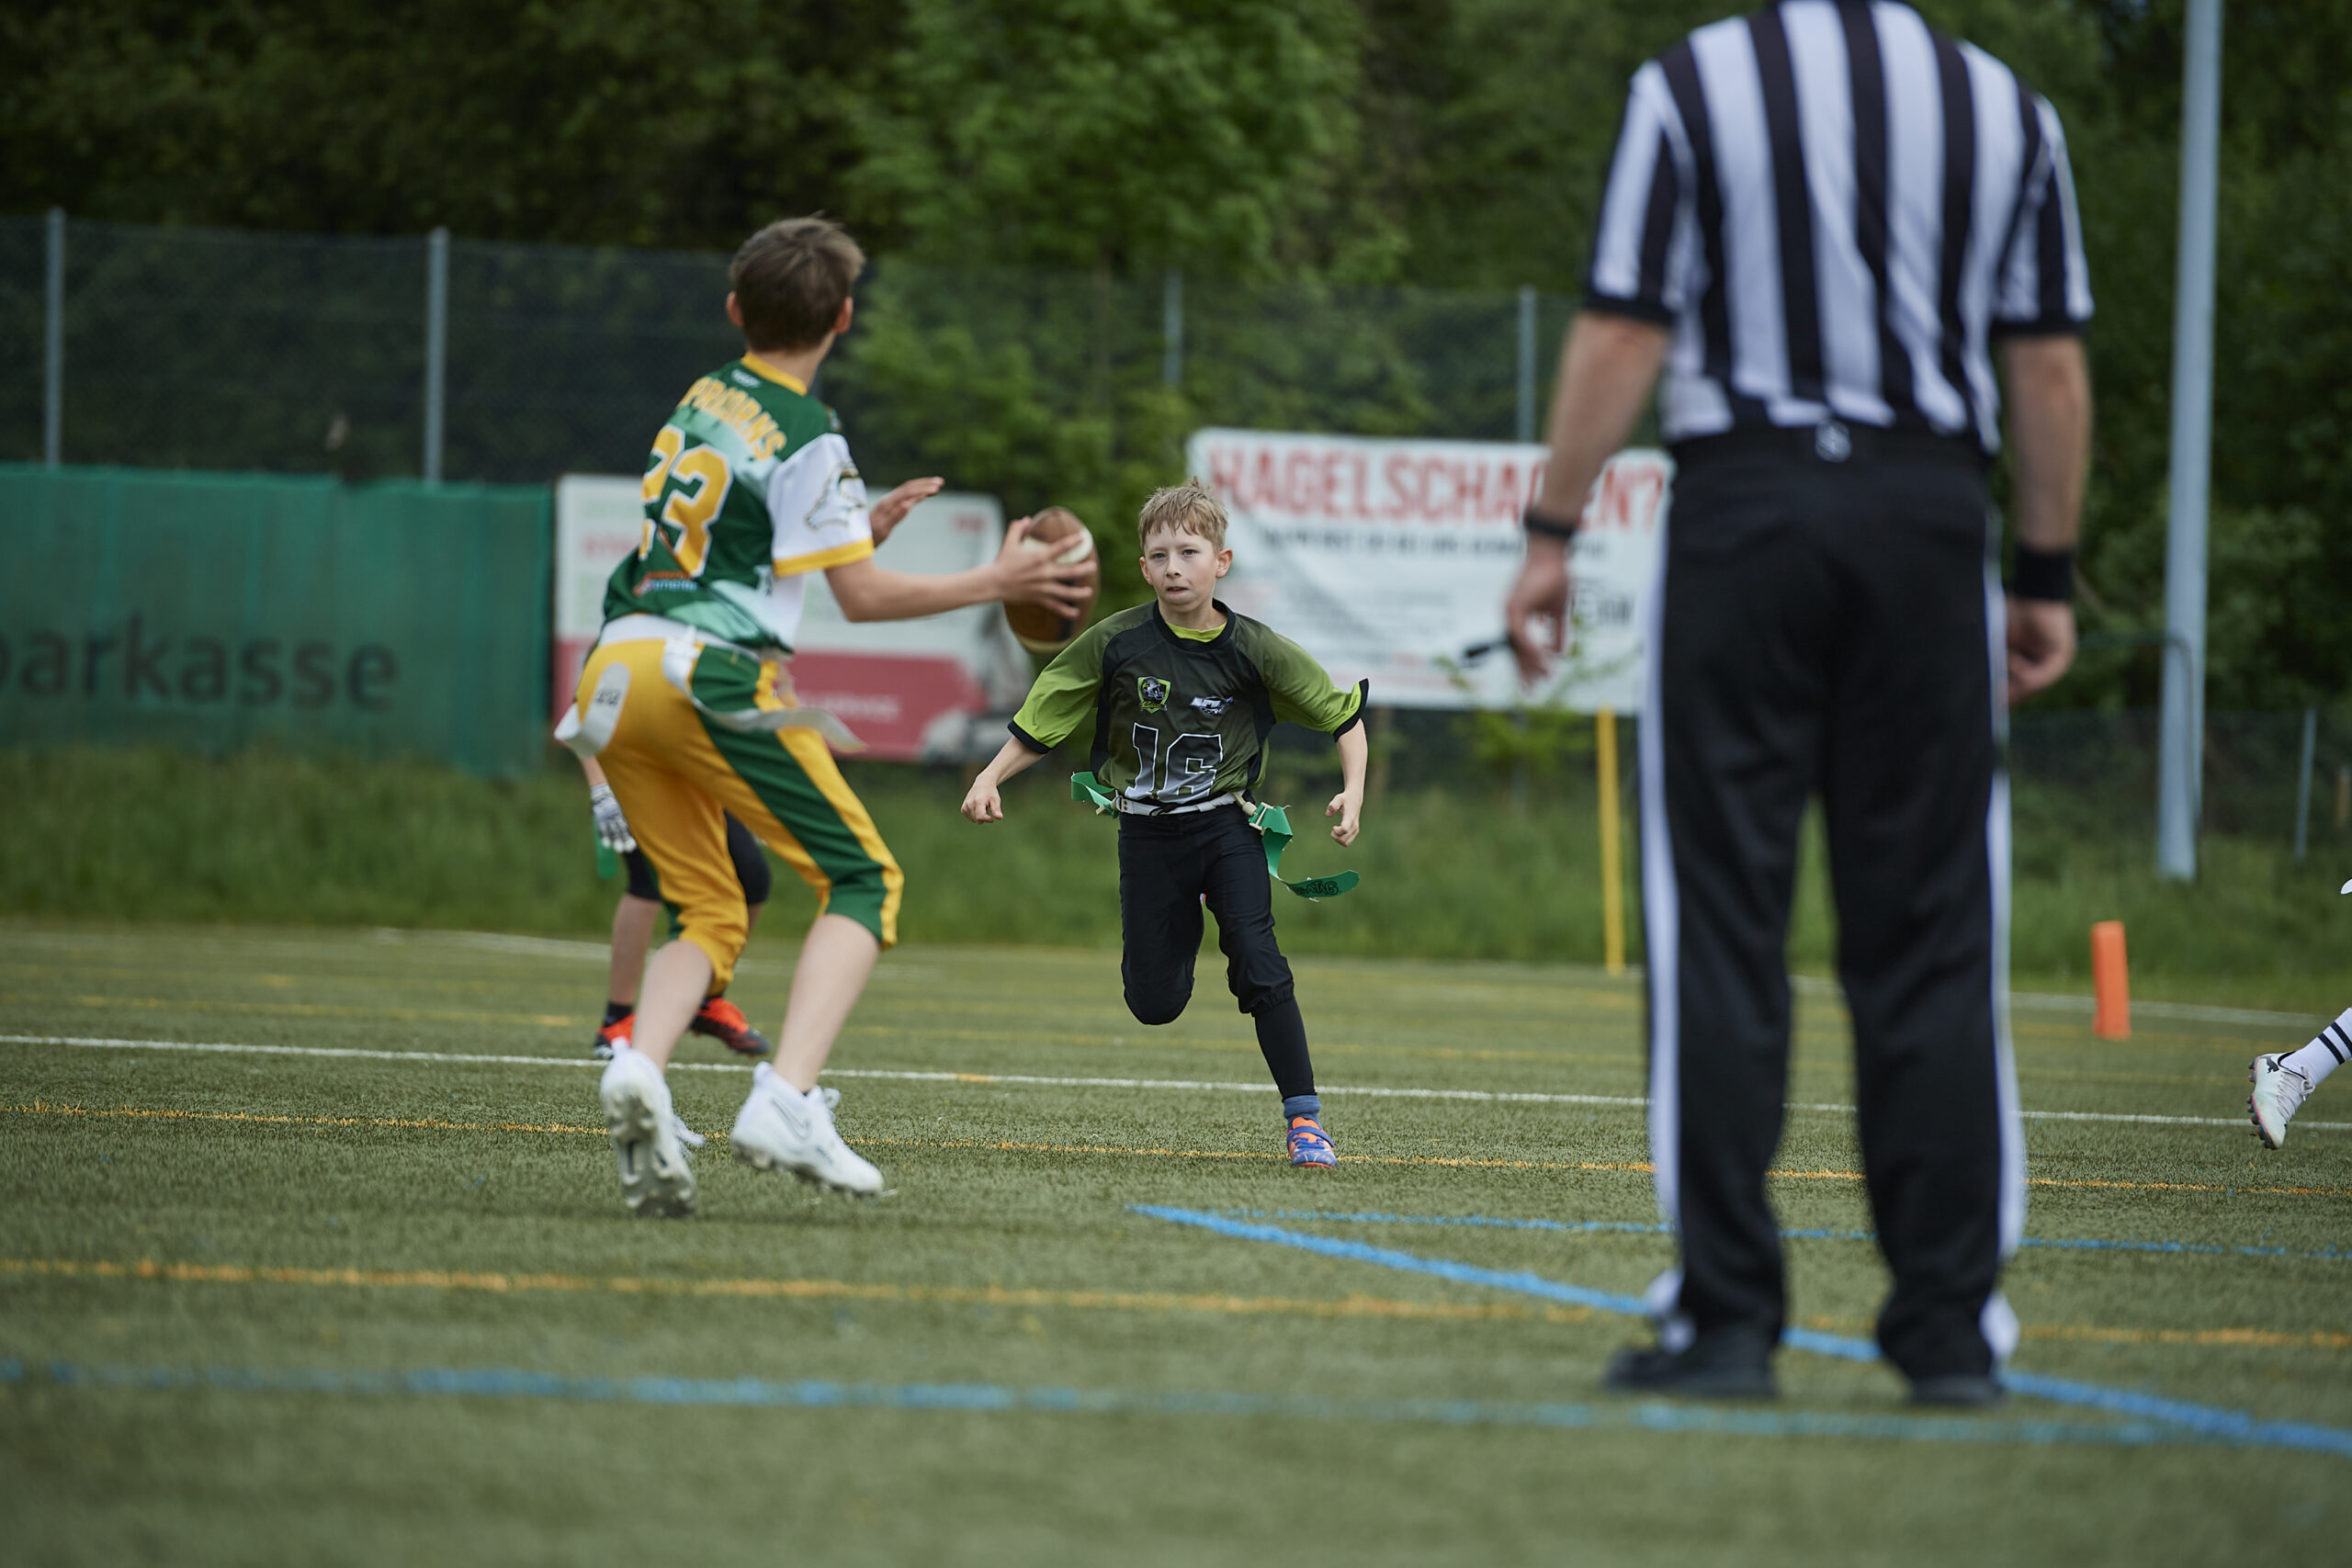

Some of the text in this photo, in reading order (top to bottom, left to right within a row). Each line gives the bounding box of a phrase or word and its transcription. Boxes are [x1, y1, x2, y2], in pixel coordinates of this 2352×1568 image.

[1209, 444, 1665, 535] HAGELSCHAN?
[0, 613, 398, 712] arkasse
[1125, 722, 1224, 804] 16
